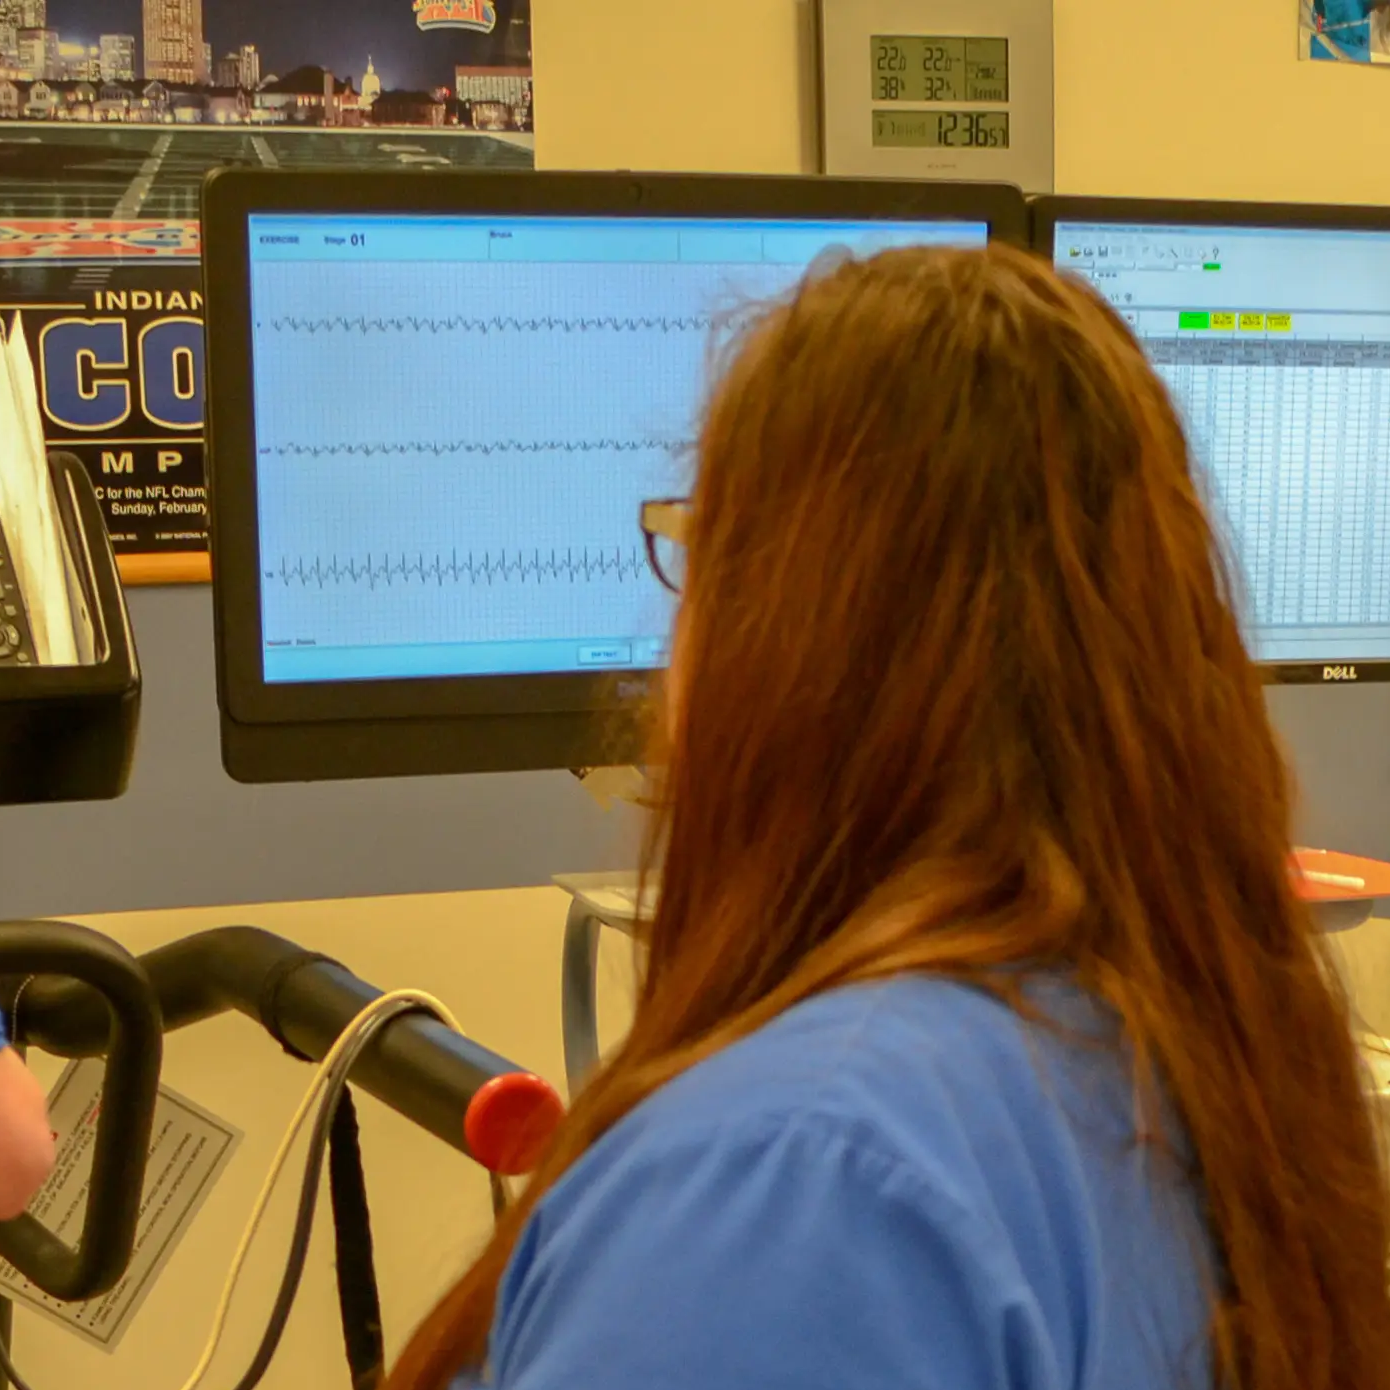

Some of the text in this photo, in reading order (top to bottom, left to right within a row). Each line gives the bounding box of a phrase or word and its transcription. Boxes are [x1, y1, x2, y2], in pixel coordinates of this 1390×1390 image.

[350, 234, 366, 246] 01
[107, 486, 123, 499] for
[125, 486, 143, 499] the
[146, 486, 170, 499] NFL
[111, 501, 207, 517] Sunday, February
[1323, 665, 1357, 680] DELL
